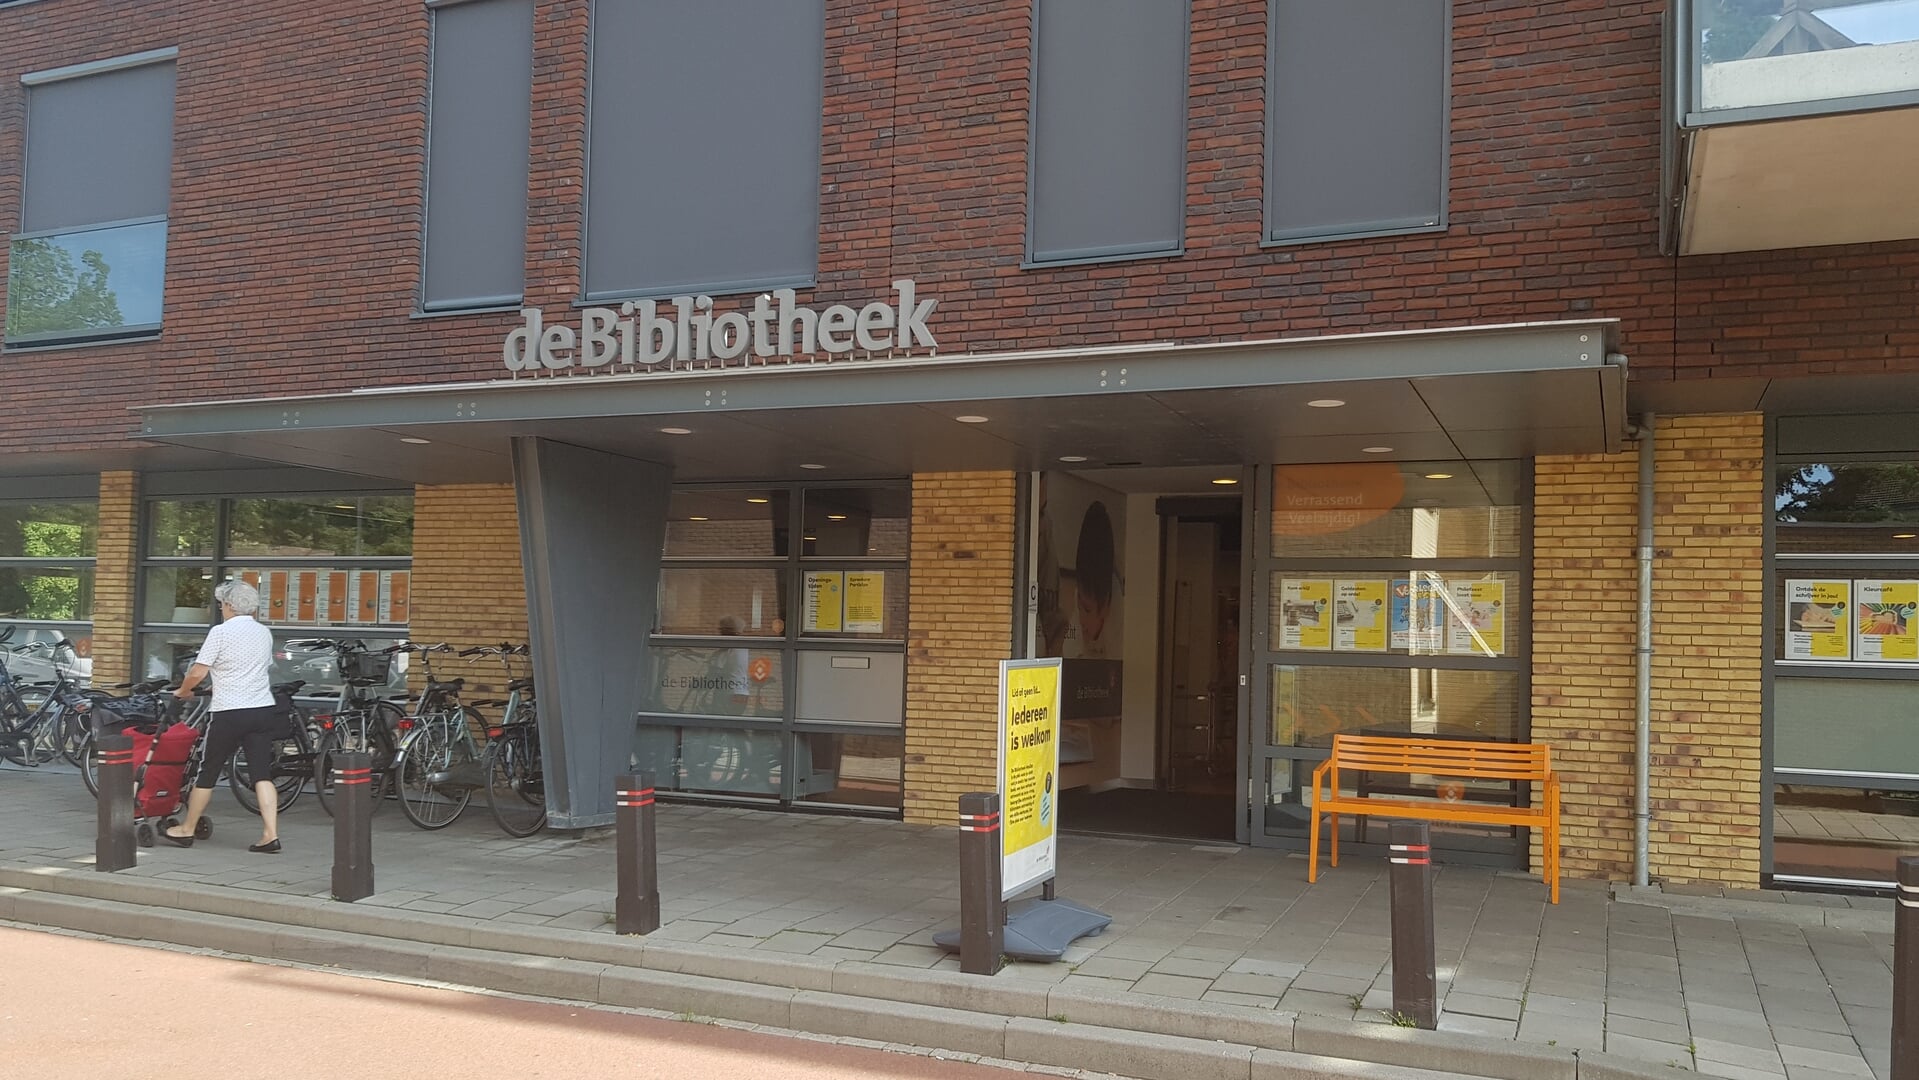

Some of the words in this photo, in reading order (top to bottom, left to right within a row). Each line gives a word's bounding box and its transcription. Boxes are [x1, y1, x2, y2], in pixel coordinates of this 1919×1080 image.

[1287, 493, 1363, 506] Verrassend
[1288, 511, 1361, 528] Veelzijdig!
[662, 676, 678, 688] de
[1011, 705, 1048, 726] Iedereen
[1010, 731, 1019, 751] is
[1021, 726, 1051, 749] welkom
